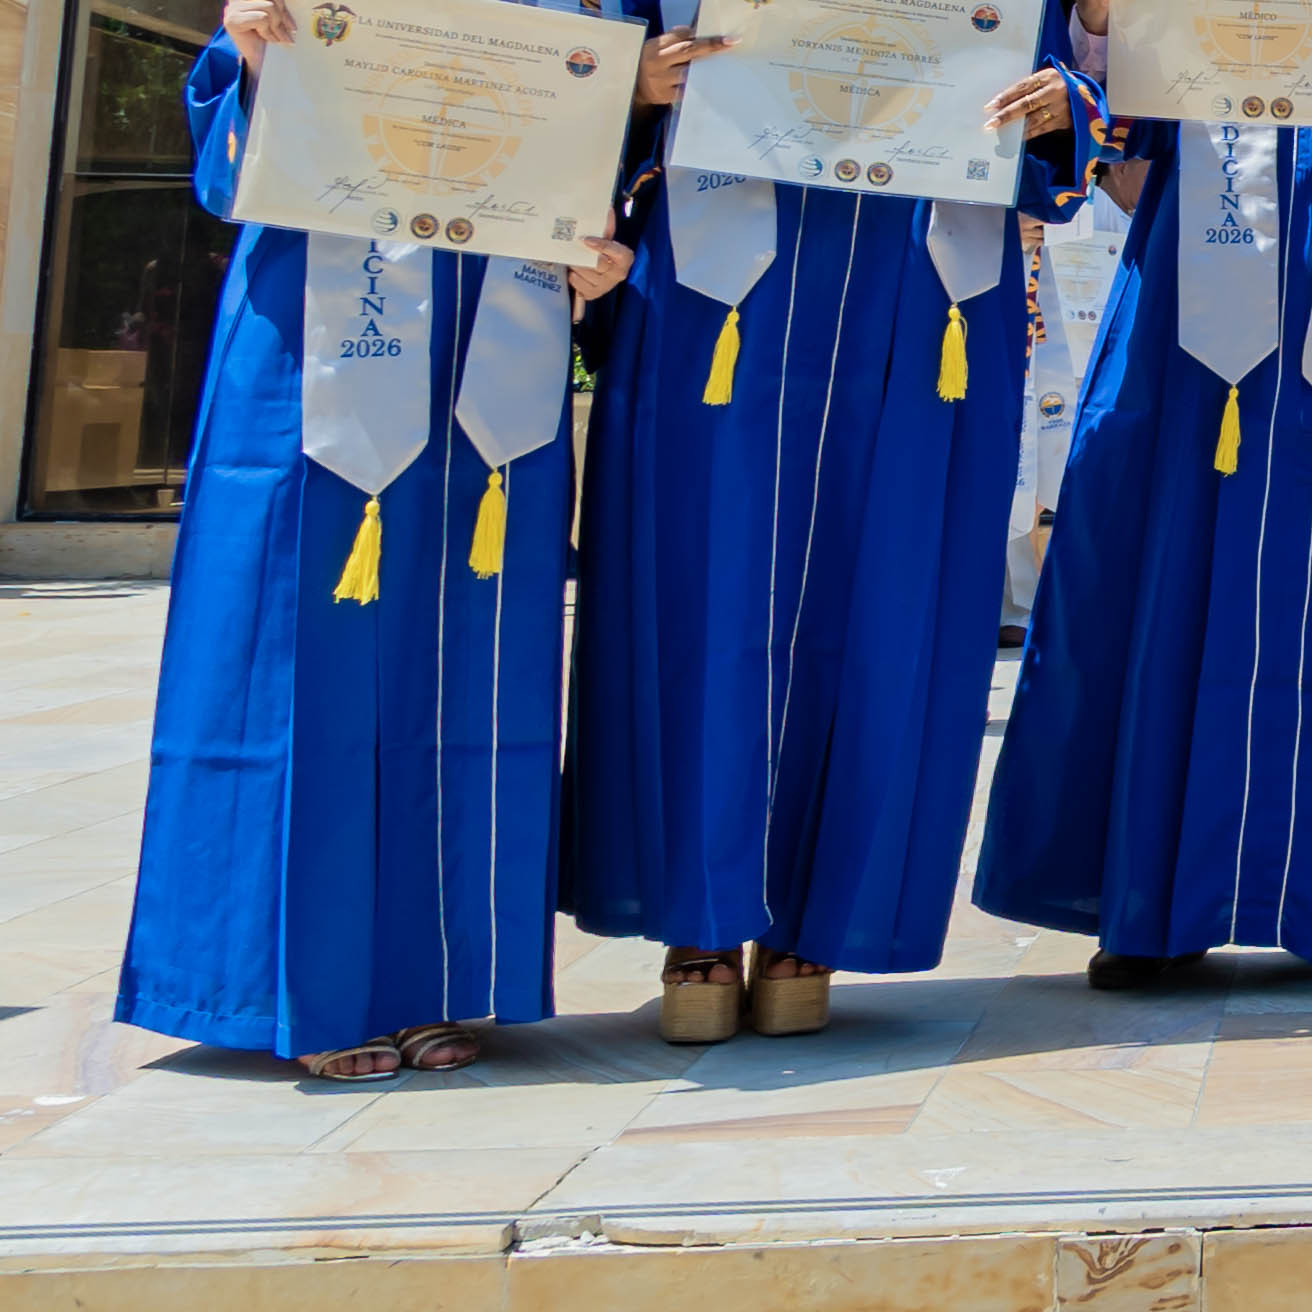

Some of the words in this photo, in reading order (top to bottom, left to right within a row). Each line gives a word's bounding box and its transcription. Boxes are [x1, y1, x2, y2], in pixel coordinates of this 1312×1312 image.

[359, 16, 372, 26] LA
[378, 19, 458, 40] UNIVERSIDAD
[463, 34, 484, 44] DEL
[488, 37, 560, 56] MAGDALENA
[846, 46, 896, 59] MENDOZA
[902, 53, 940, 64] TORRES
[392, 66, 450, 82] CAROLINA
[516, 86, 557, 99] ACOSTA
[1206, 228, 1254, 244] 2026
[514, 272, 562, 293] MARTINEZ
[522, 264, 558, 282] MAYLID
[340, 339, 402, 358] 2026
